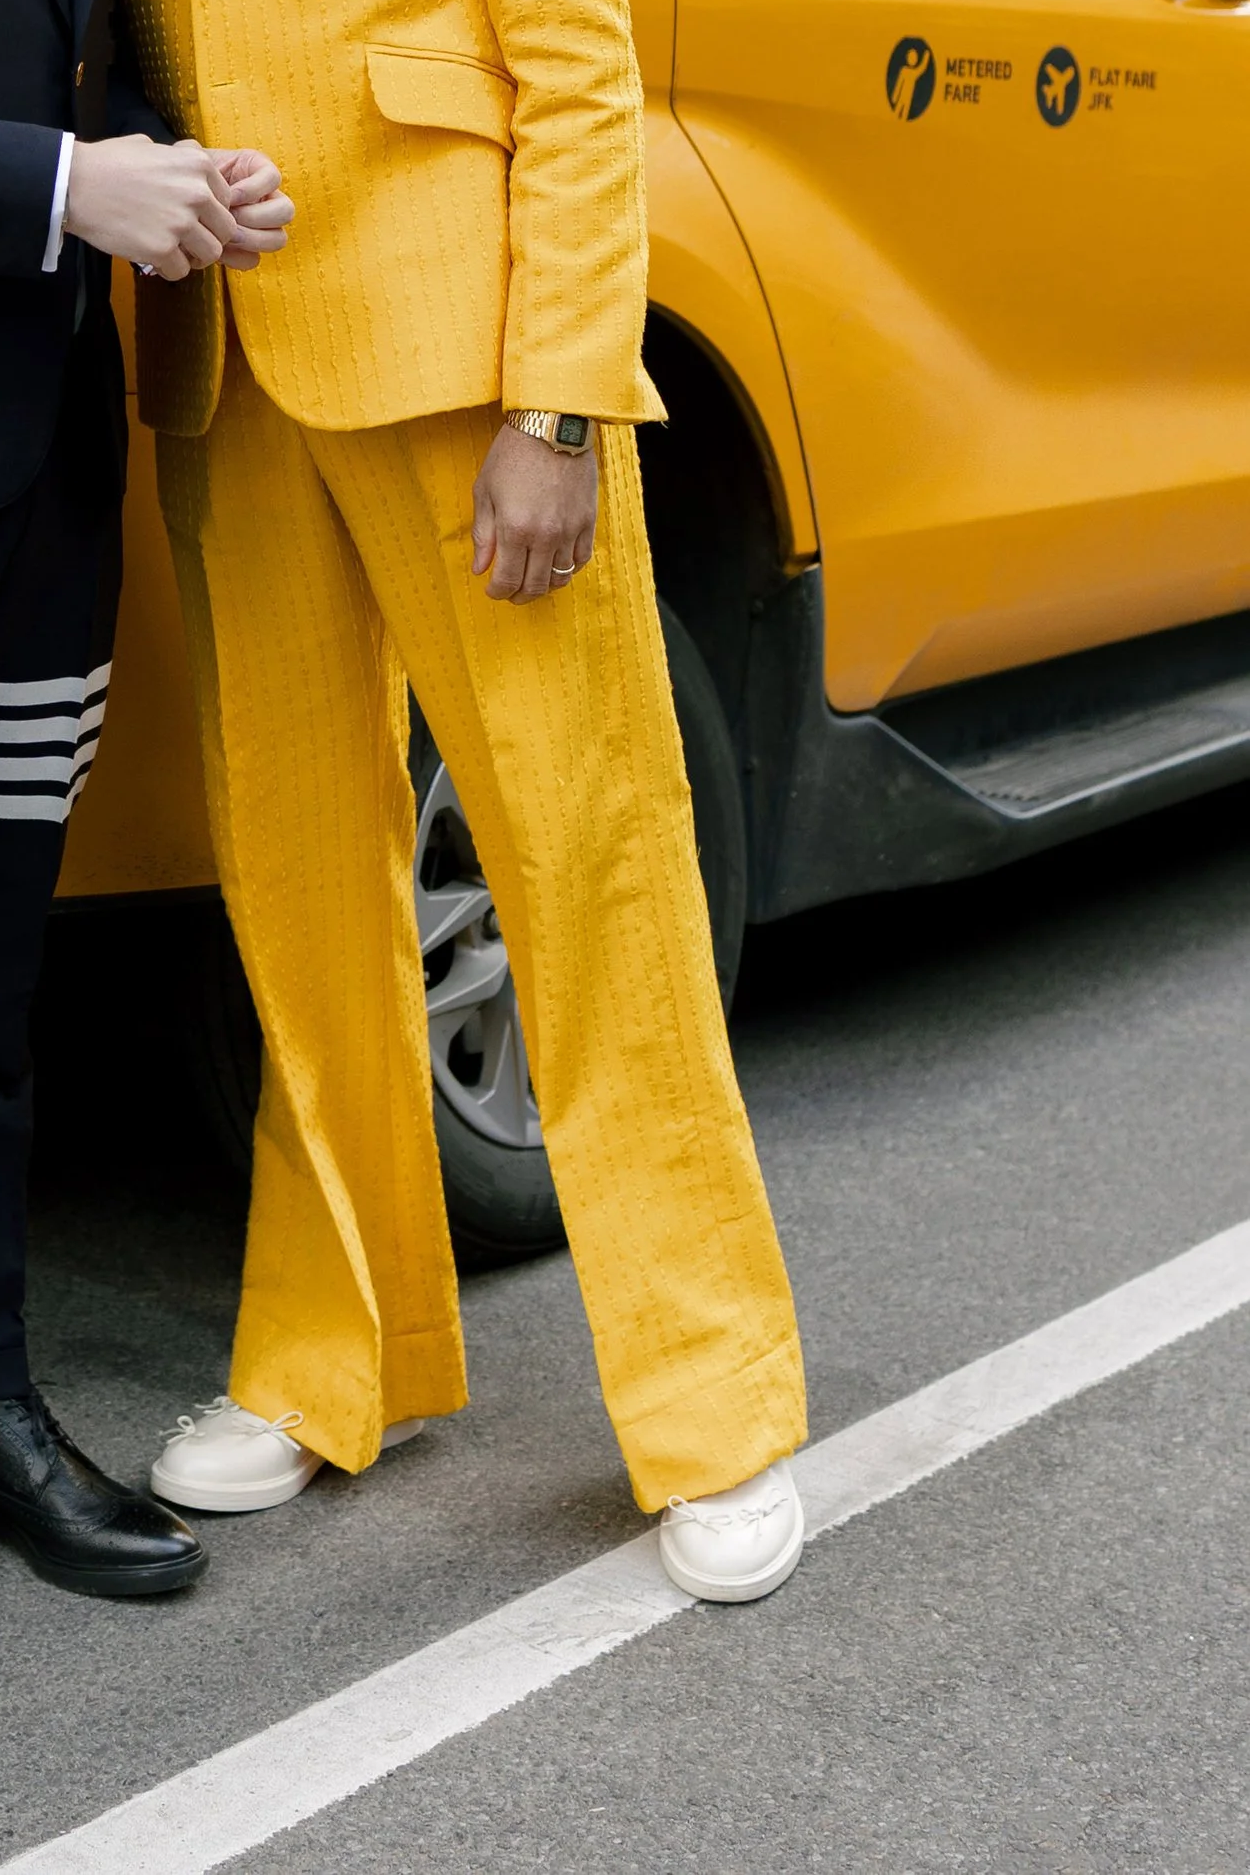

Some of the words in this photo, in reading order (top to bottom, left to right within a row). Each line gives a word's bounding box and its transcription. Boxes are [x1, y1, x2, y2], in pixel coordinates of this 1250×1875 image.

[946, 58, 1012, 81] METERED
[1089, 67, 1120, 87] FLAT
[1124, 70, 1156, 90] FARE
[944, 84, 980, 104] FARE
[1087, 93, 1113, 111] JFK
